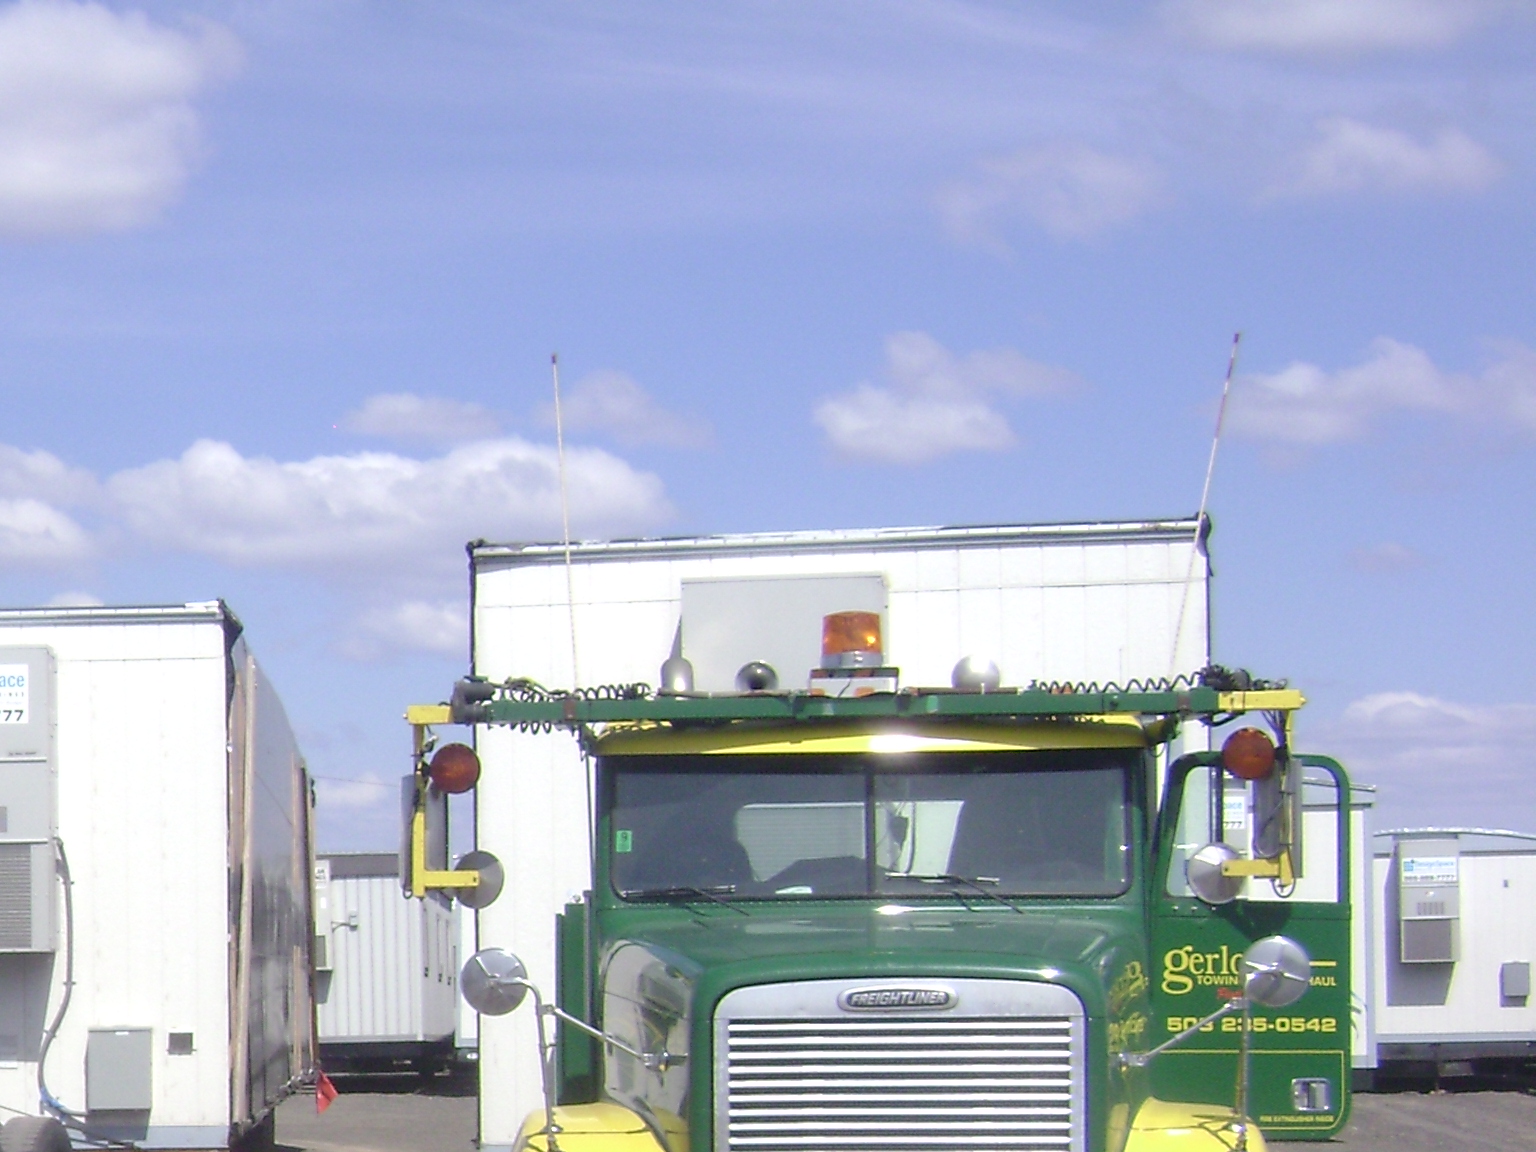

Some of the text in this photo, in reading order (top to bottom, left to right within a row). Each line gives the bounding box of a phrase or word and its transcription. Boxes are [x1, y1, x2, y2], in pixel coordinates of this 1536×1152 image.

[1197, 974, 1238, 986] TOWIN
[851, 989, 946, 1006] FREIGHTLINER
[1167, 1016, 1337, 1033] 503 235-0542
